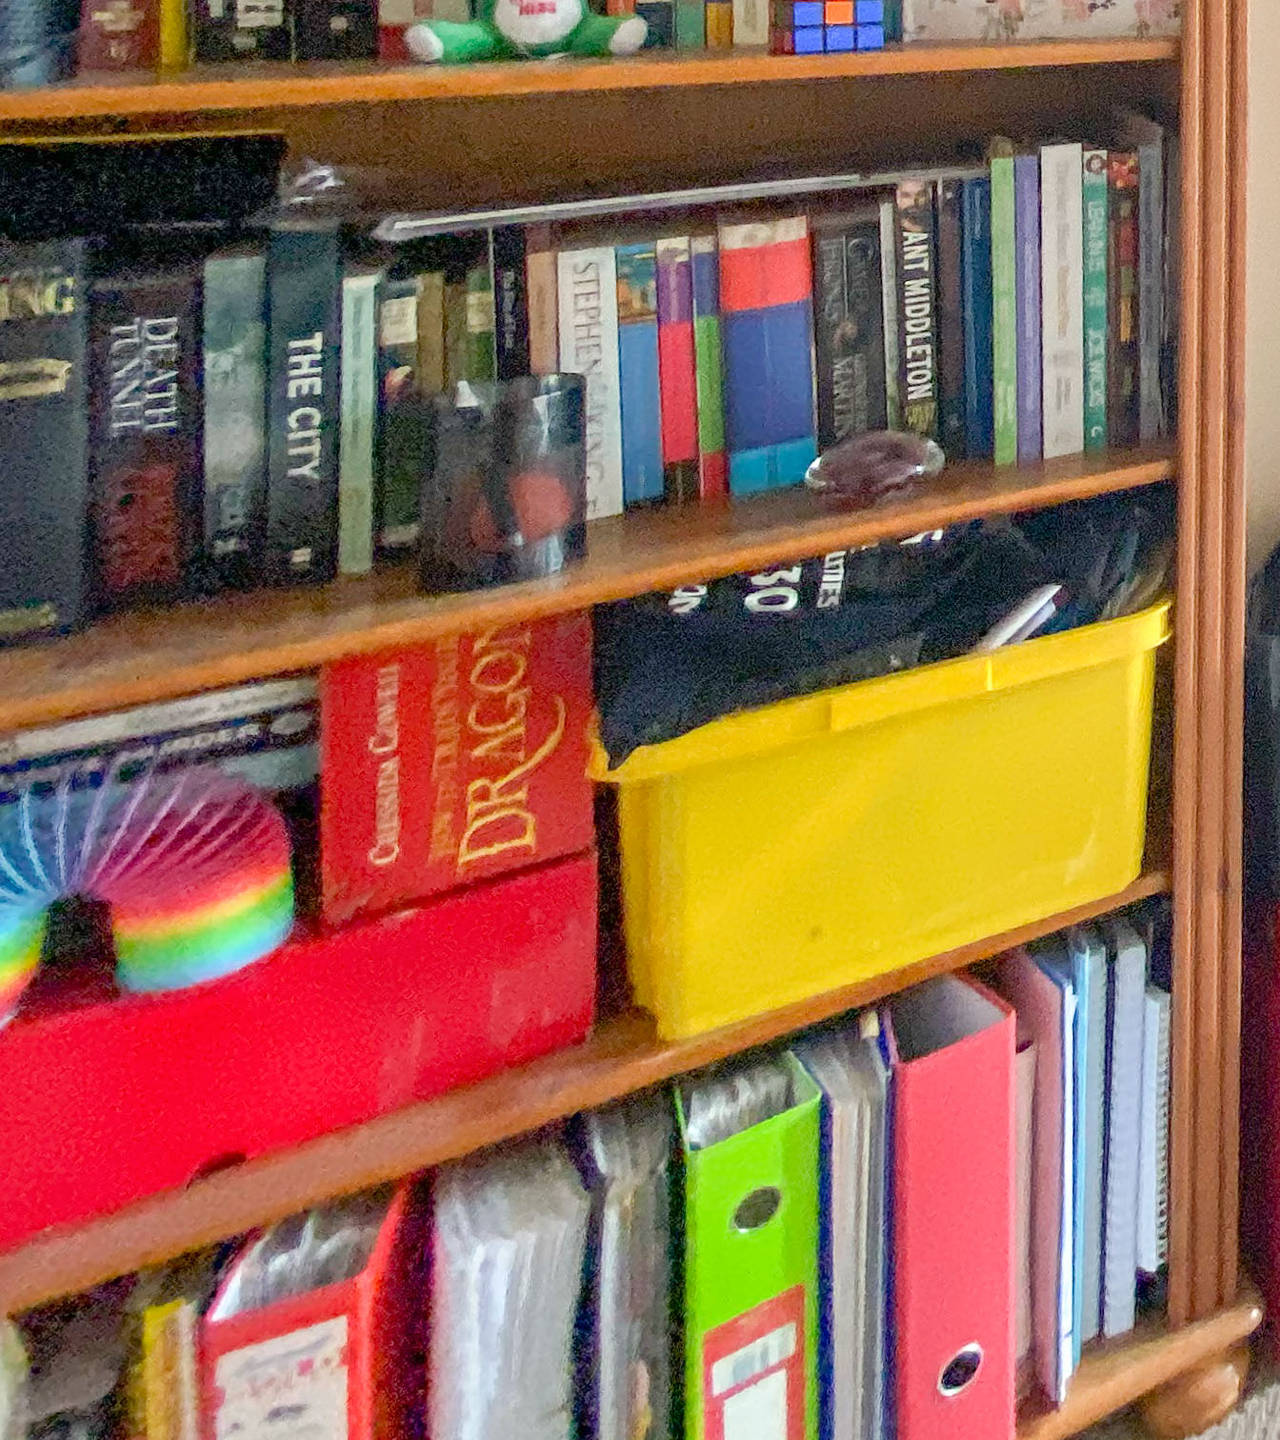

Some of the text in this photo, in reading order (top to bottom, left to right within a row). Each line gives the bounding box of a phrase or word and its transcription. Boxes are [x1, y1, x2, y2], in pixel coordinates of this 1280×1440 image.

[143, 316, 180, 432] DEATH
[572, 261, 605, 376] STEPHEN
[902, 230, 936, 401] ANT MIDDLETON
[286, 331, 324, 482] THE CITY
